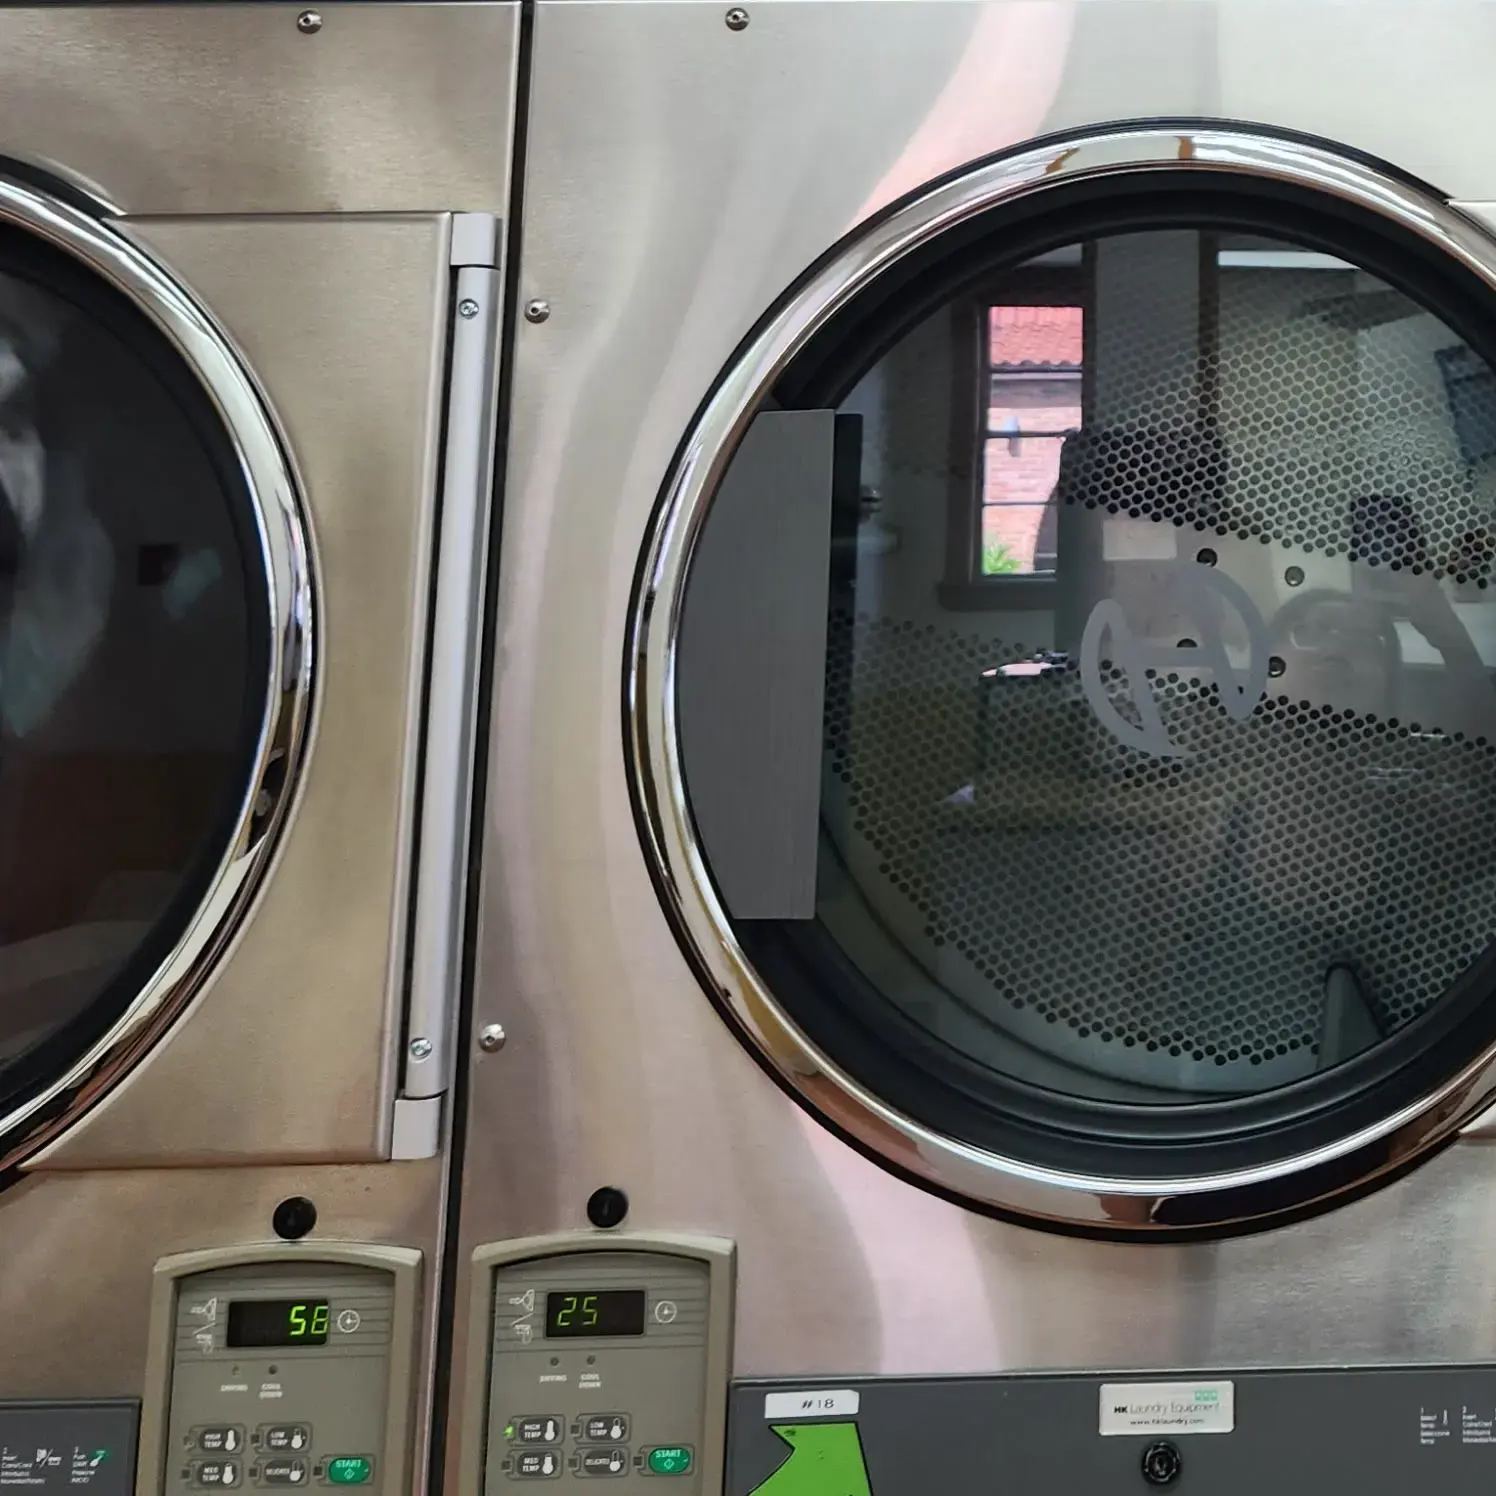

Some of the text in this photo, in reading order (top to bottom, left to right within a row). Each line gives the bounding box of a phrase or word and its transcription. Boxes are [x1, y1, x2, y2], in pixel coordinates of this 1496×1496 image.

[556, 1295, 599, 1327] 25
[801, 1398, 835, 1409] #18
[655, 1449, 681, 1459] START
[335, 1458, 362, 1469] START
